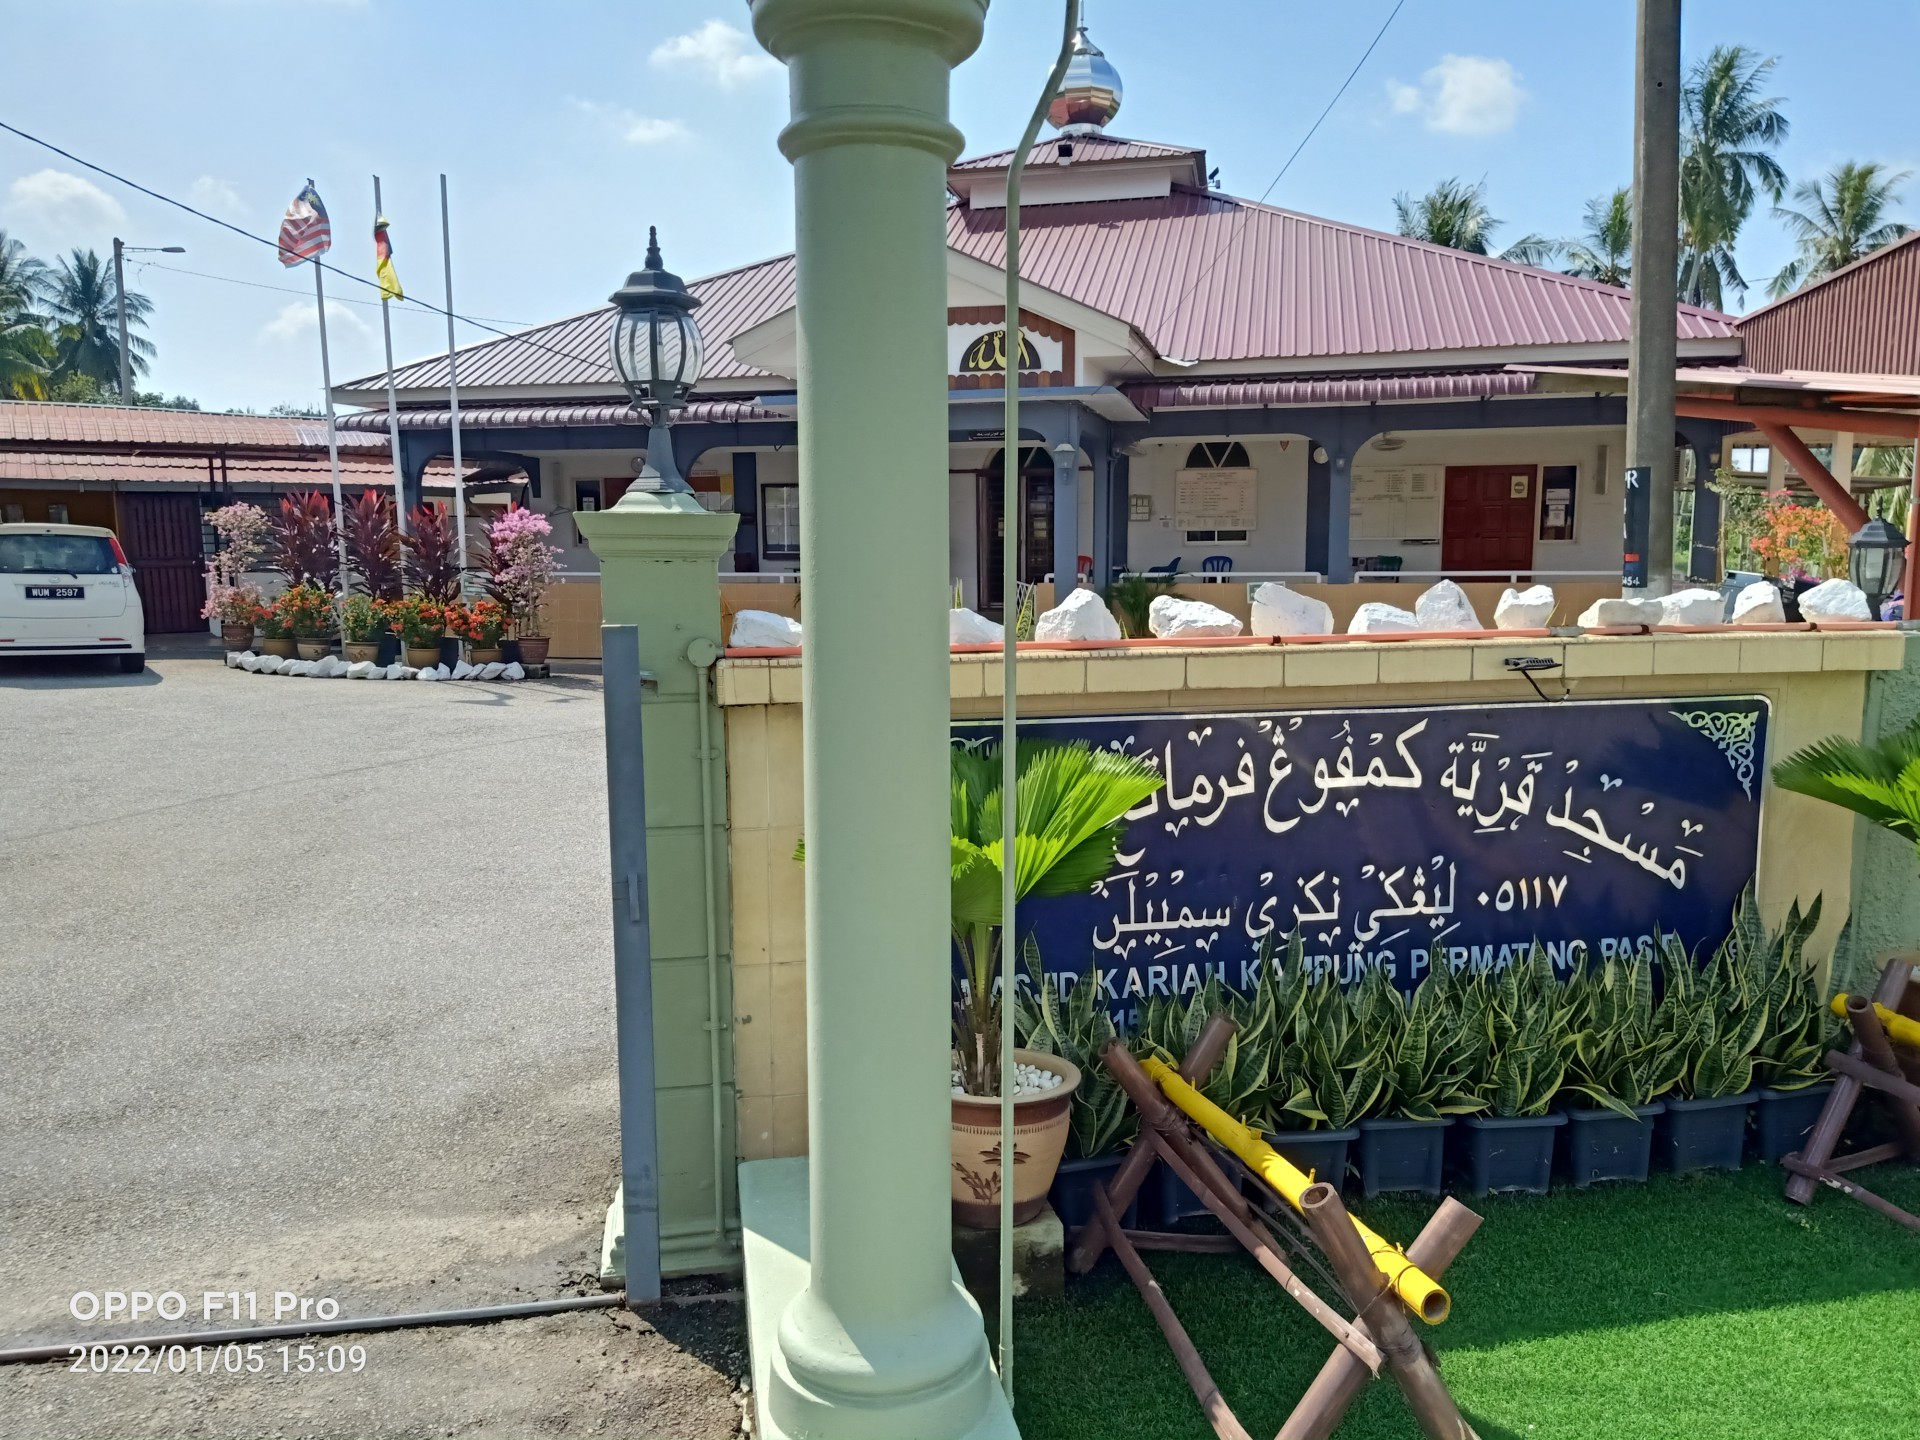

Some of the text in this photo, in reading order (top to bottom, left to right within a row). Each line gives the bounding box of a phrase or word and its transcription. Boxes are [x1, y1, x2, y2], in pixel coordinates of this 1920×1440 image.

[31, 588, 78, 597] WUM 2597
[1097, 961, 1225, 1000] KARIAH
